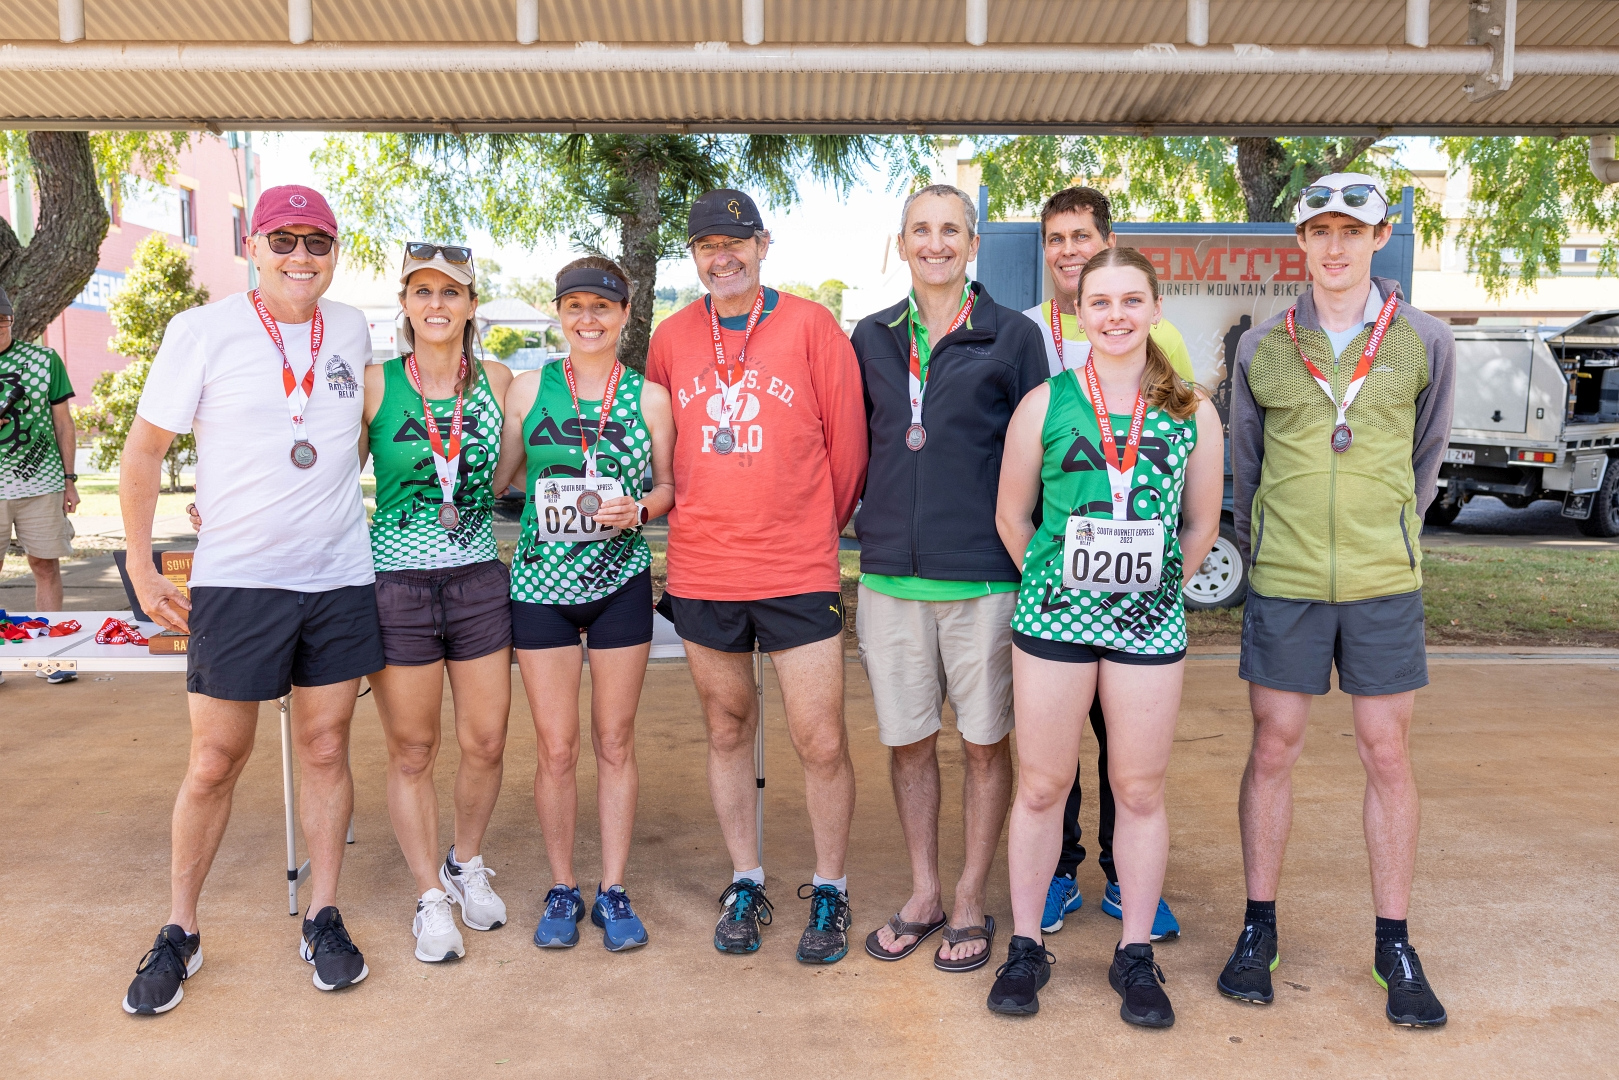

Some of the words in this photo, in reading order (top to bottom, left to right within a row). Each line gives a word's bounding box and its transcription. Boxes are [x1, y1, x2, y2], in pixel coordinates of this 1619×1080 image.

[1139, 247, 1313, 281] BMTB
[1157, 283, 1200, 296] URNETT
[1207, 283, 1266, 297] MOUNTAIN
[1273, 284, 1299, 297] BIKE
[949, 299, 974, 333] CHAMPIO
[1364, 291, 1398, 358] HAMPIONSHIPS
[714, 341, 726, 365] STATE
[603, 358, 621, 410] CHAMPIONS
[766, 376, 795, 409] ED.
[424, 408, 438, 434] STATE
[529, 416, 634, 455] ASR
[1099, 416, 1113, 443] STATE
[702, 425, 763, 453] PLO
[12, 431, 47, 478] ASHGROVE
[22, 440, 51, 481] RANGERS
[560, 484, 575, 493] SOUTH
[596, 483, 614, 492] XPRESS
[545, 505, 614, 535] 020
[1096, 527, 1113, 536] SOUTH
[1113, 528, 1135, 537] BURNETT
[1136, 528, 1155, 537] EXPRESS
[1120, 536, 1133, 544] 2023
[166, 557, 193, 571] SOUT
[1072, 548, 1153, 585] 0205
[173, 640, 187, 651] RA
